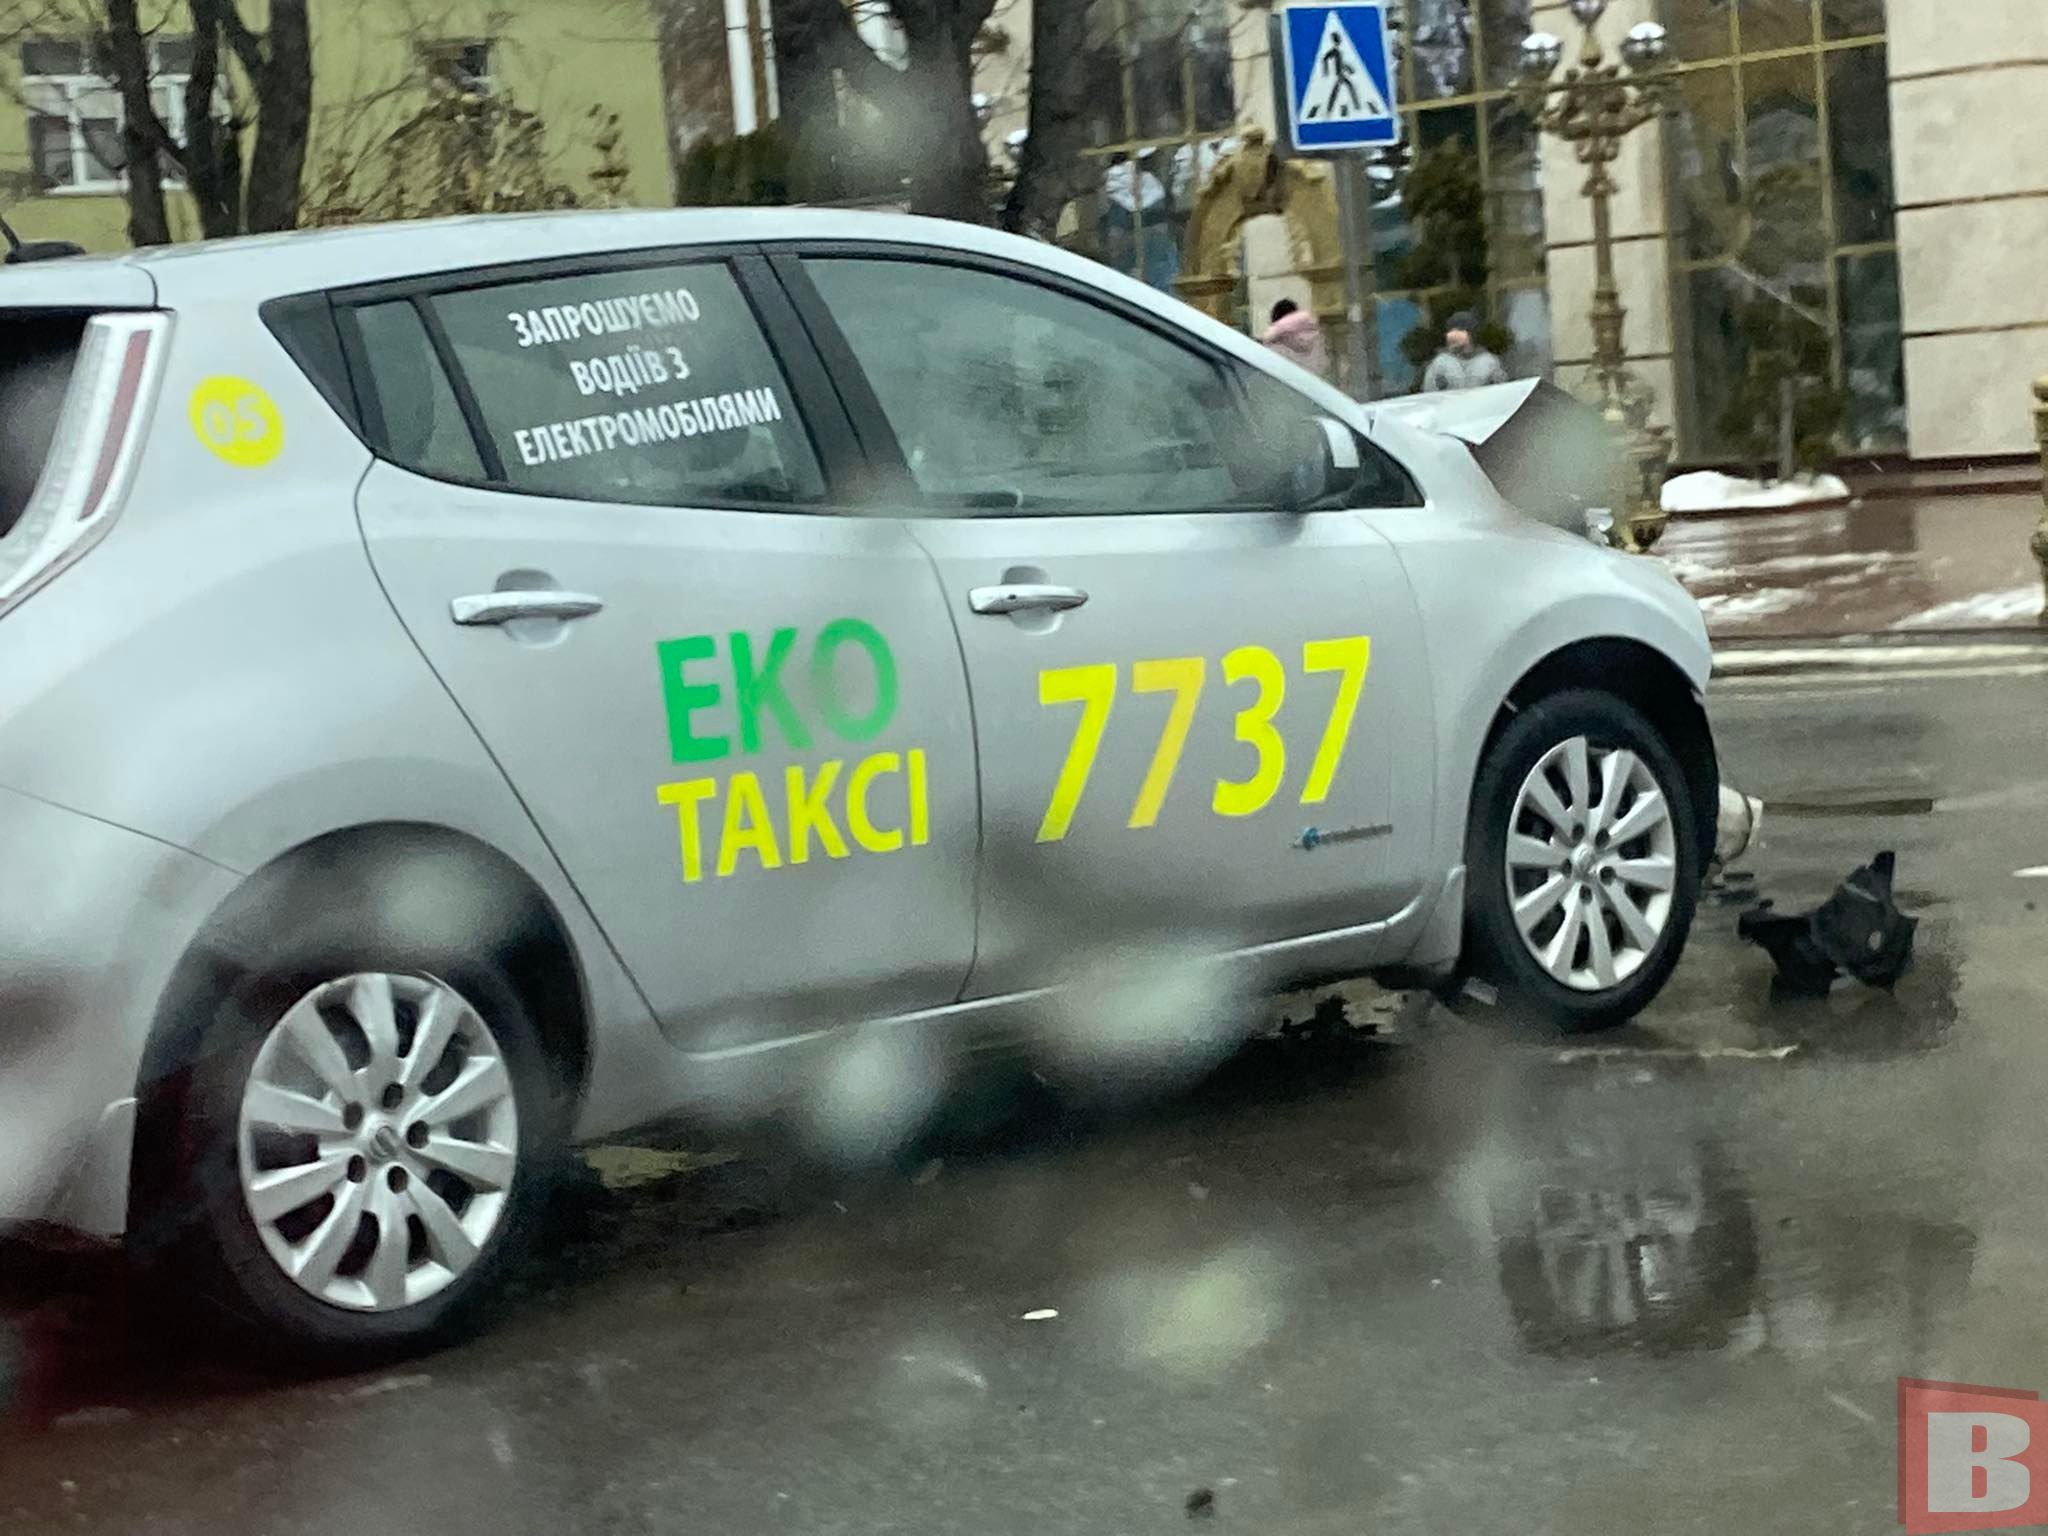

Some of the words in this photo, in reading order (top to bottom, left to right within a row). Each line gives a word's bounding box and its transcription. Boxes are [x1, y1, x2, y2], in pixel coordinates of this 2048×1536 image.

[508, 288, 701, 347] ЗАПРОШУЄМО
[569, 344, 668, 396] ВОДІЇВ
[203, 394, 268, 446] 05
[513, 386, 783, 466] ЕЛЕКТРОМОБІЛЯМИ
[656, 617, 900, 764] ЕКО
[1035, 635, 1371, 844] 7737
[656, 748, 929, 883] ТАКСІ
